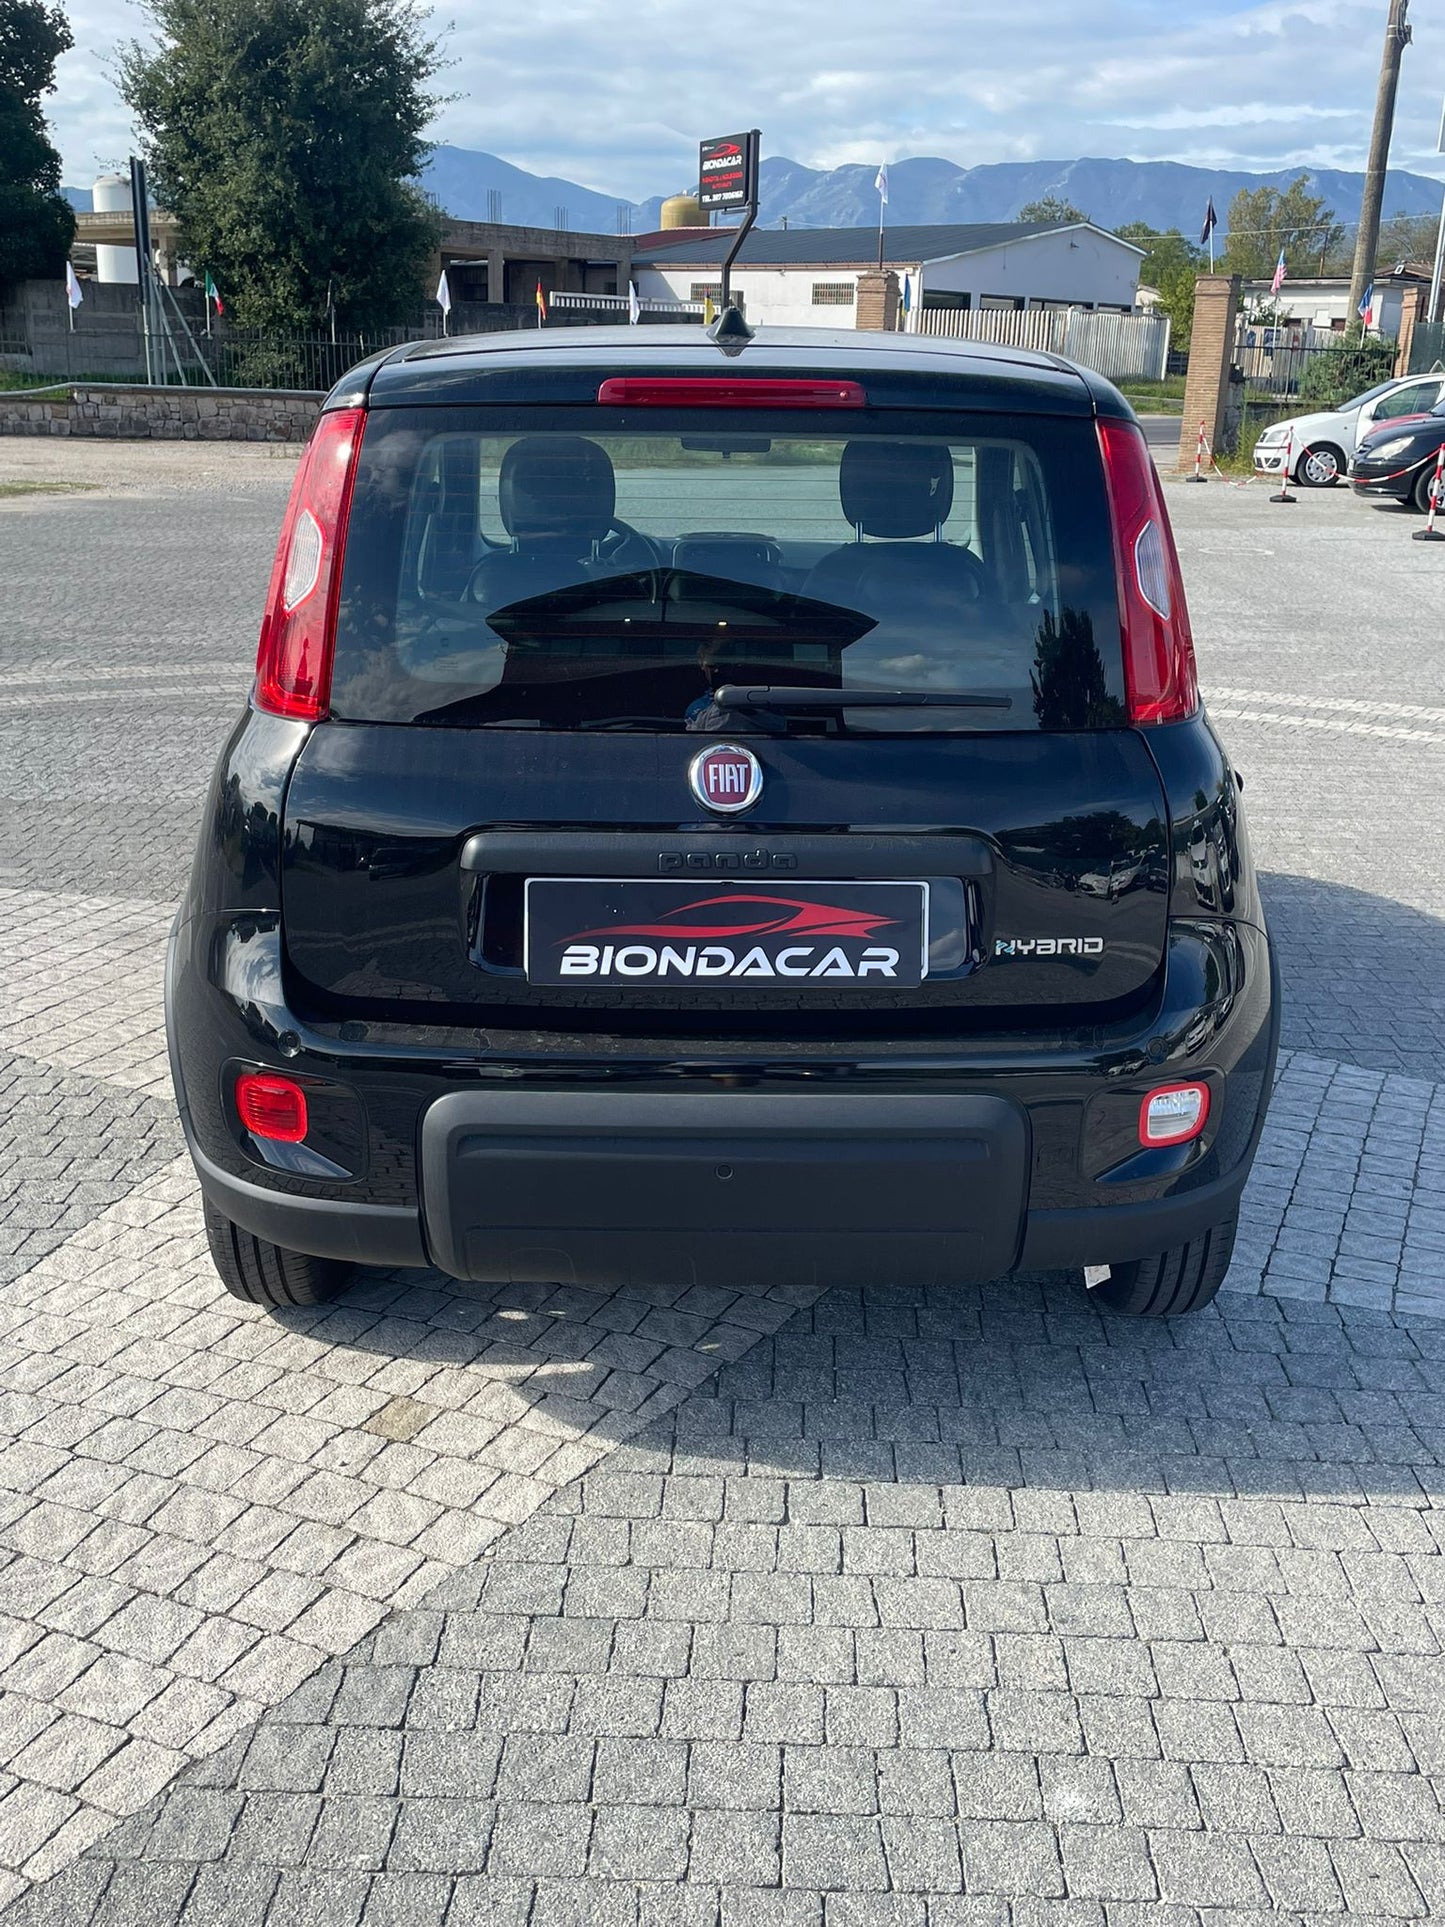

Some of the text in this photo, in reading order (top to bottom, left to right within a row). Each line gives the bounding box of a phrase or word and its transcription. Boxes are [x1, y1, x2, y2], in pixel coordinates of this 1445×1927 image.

[702, 155, 743, 171] BIONDACAR
[708, 763, 748, 793] FIAT
[658, 848, 798, 873] panda
[995, 937, 1104, 956] HYBRID
[559, 945, 900, 977] BIONDACAR
